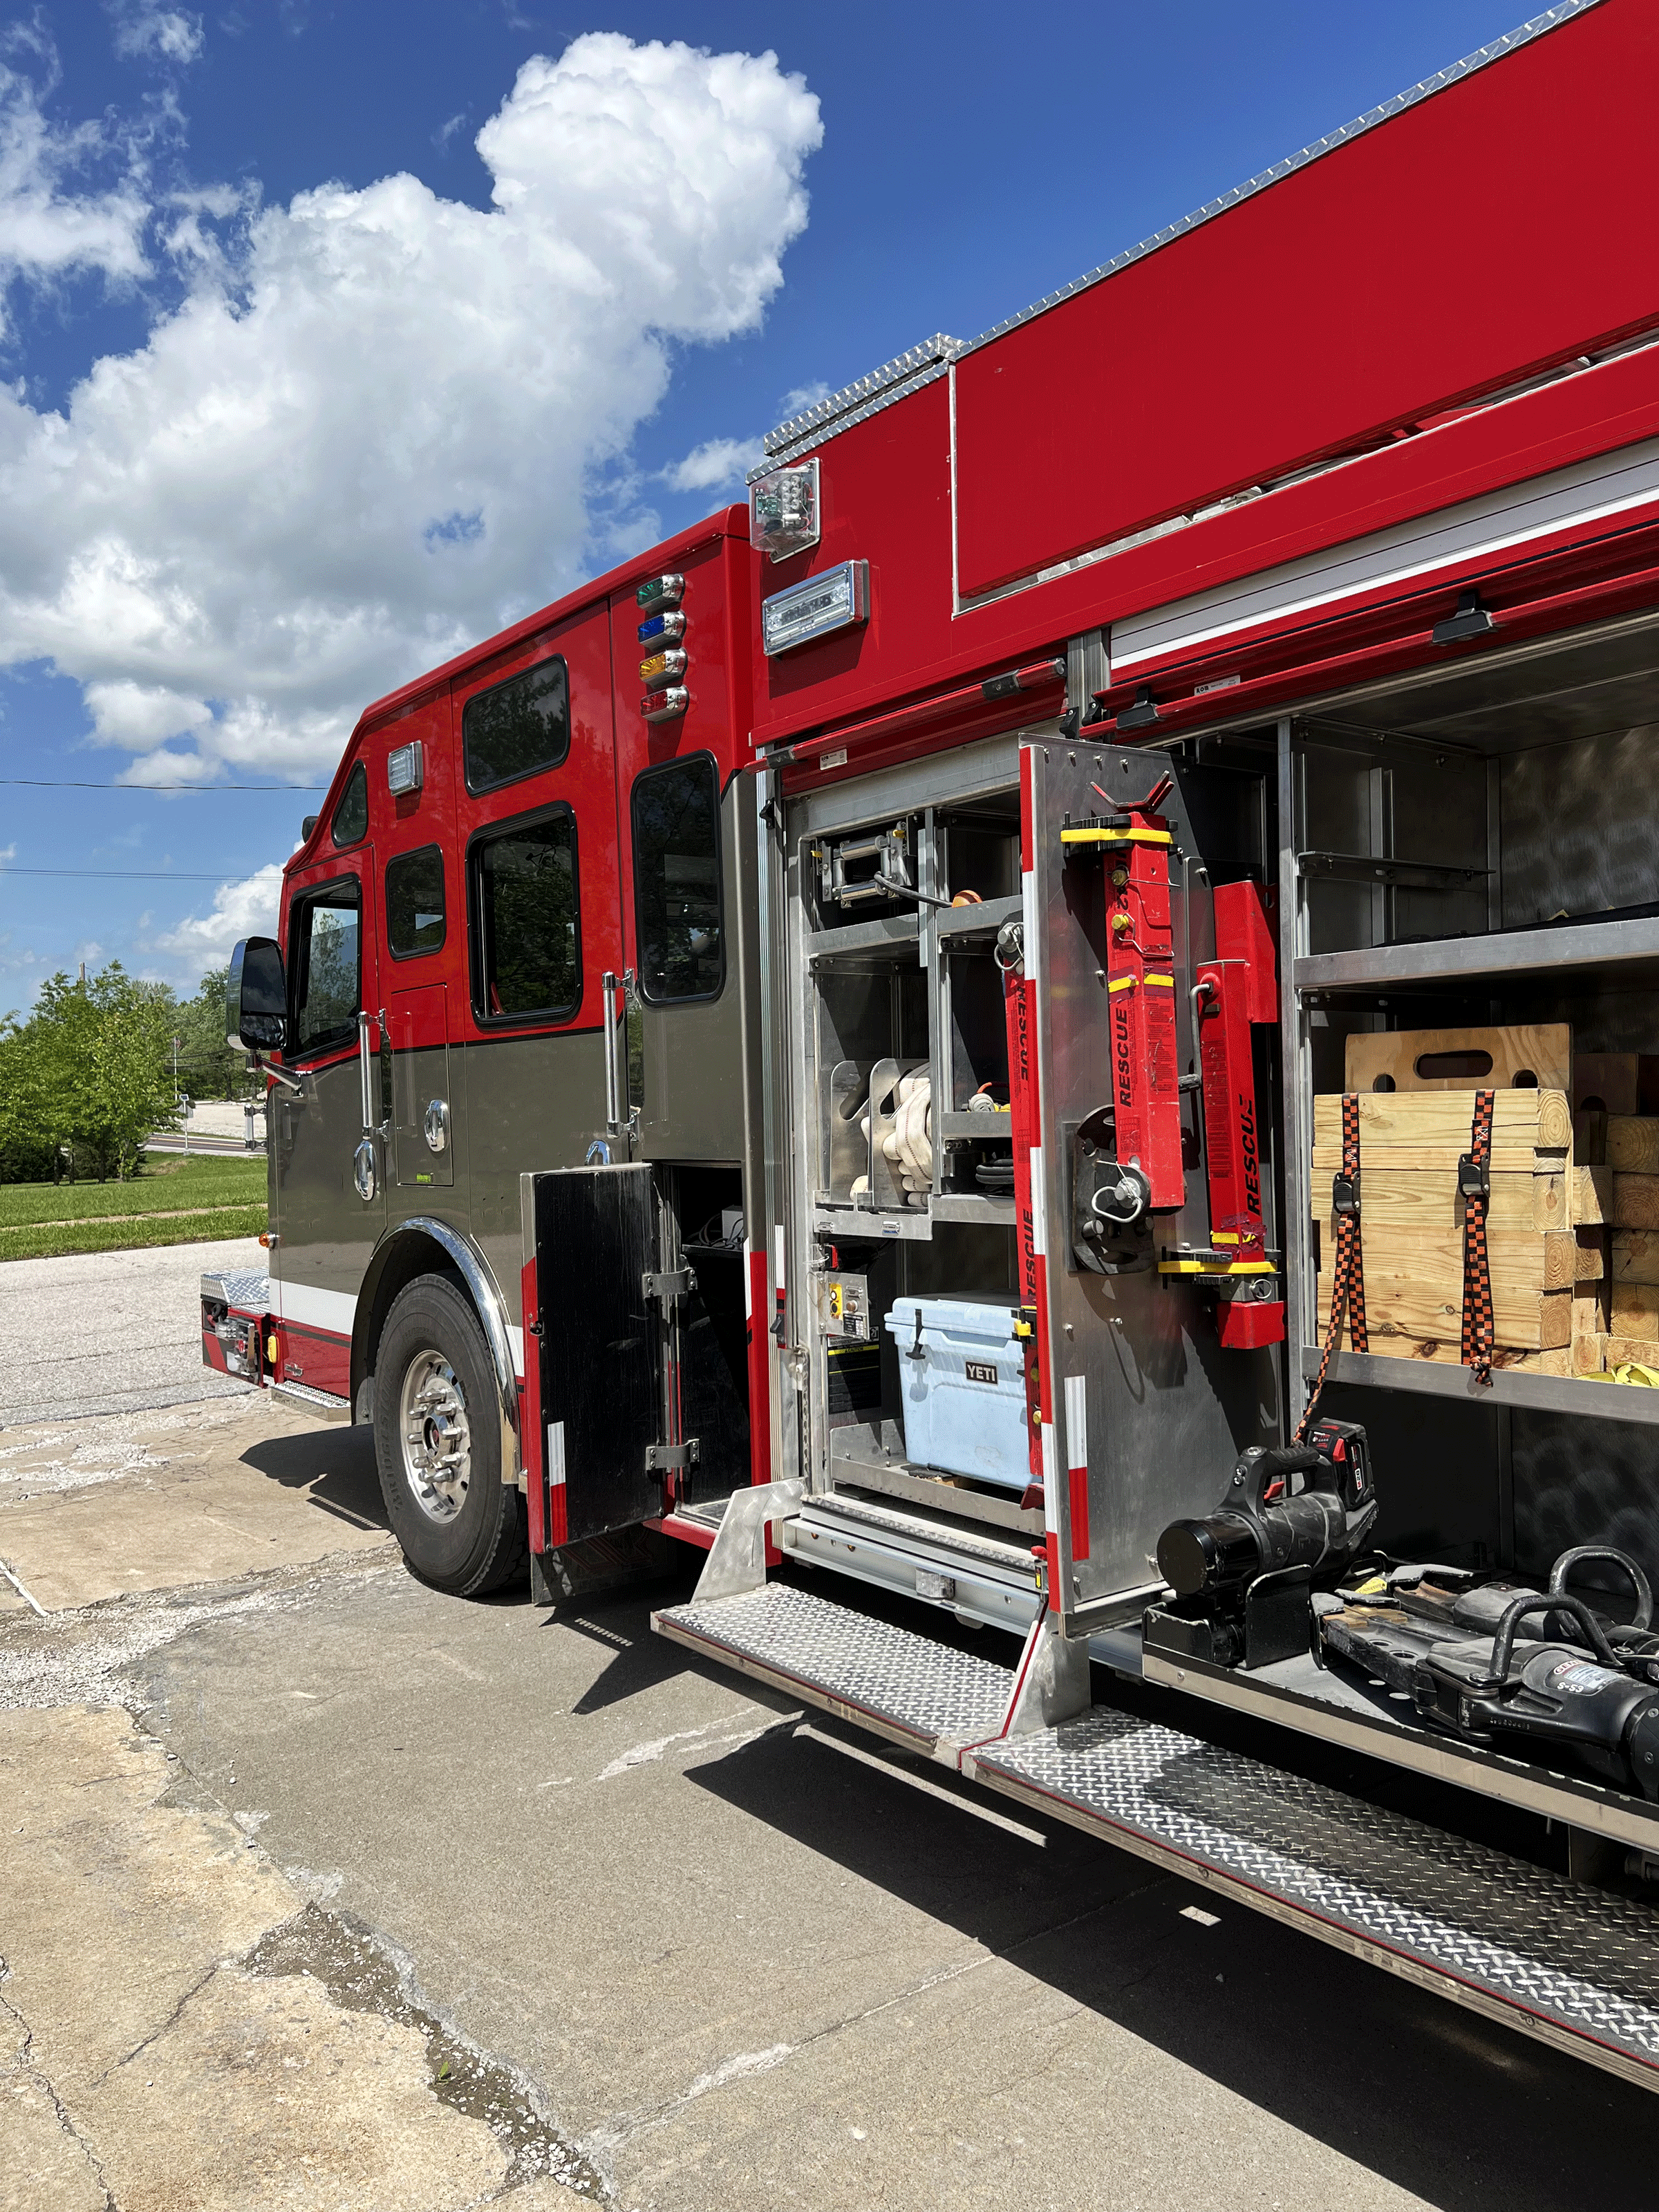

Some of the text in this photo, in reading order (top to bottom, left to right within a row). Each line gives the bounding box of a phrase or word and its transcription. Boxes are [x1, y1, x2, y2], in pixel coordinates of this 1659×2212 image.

[1115, 1006, 1132, 1108] RESCUE
[1238, 1093, 1261, 1217] RESCUE
[966, 1364, 997, 1382] YETI
